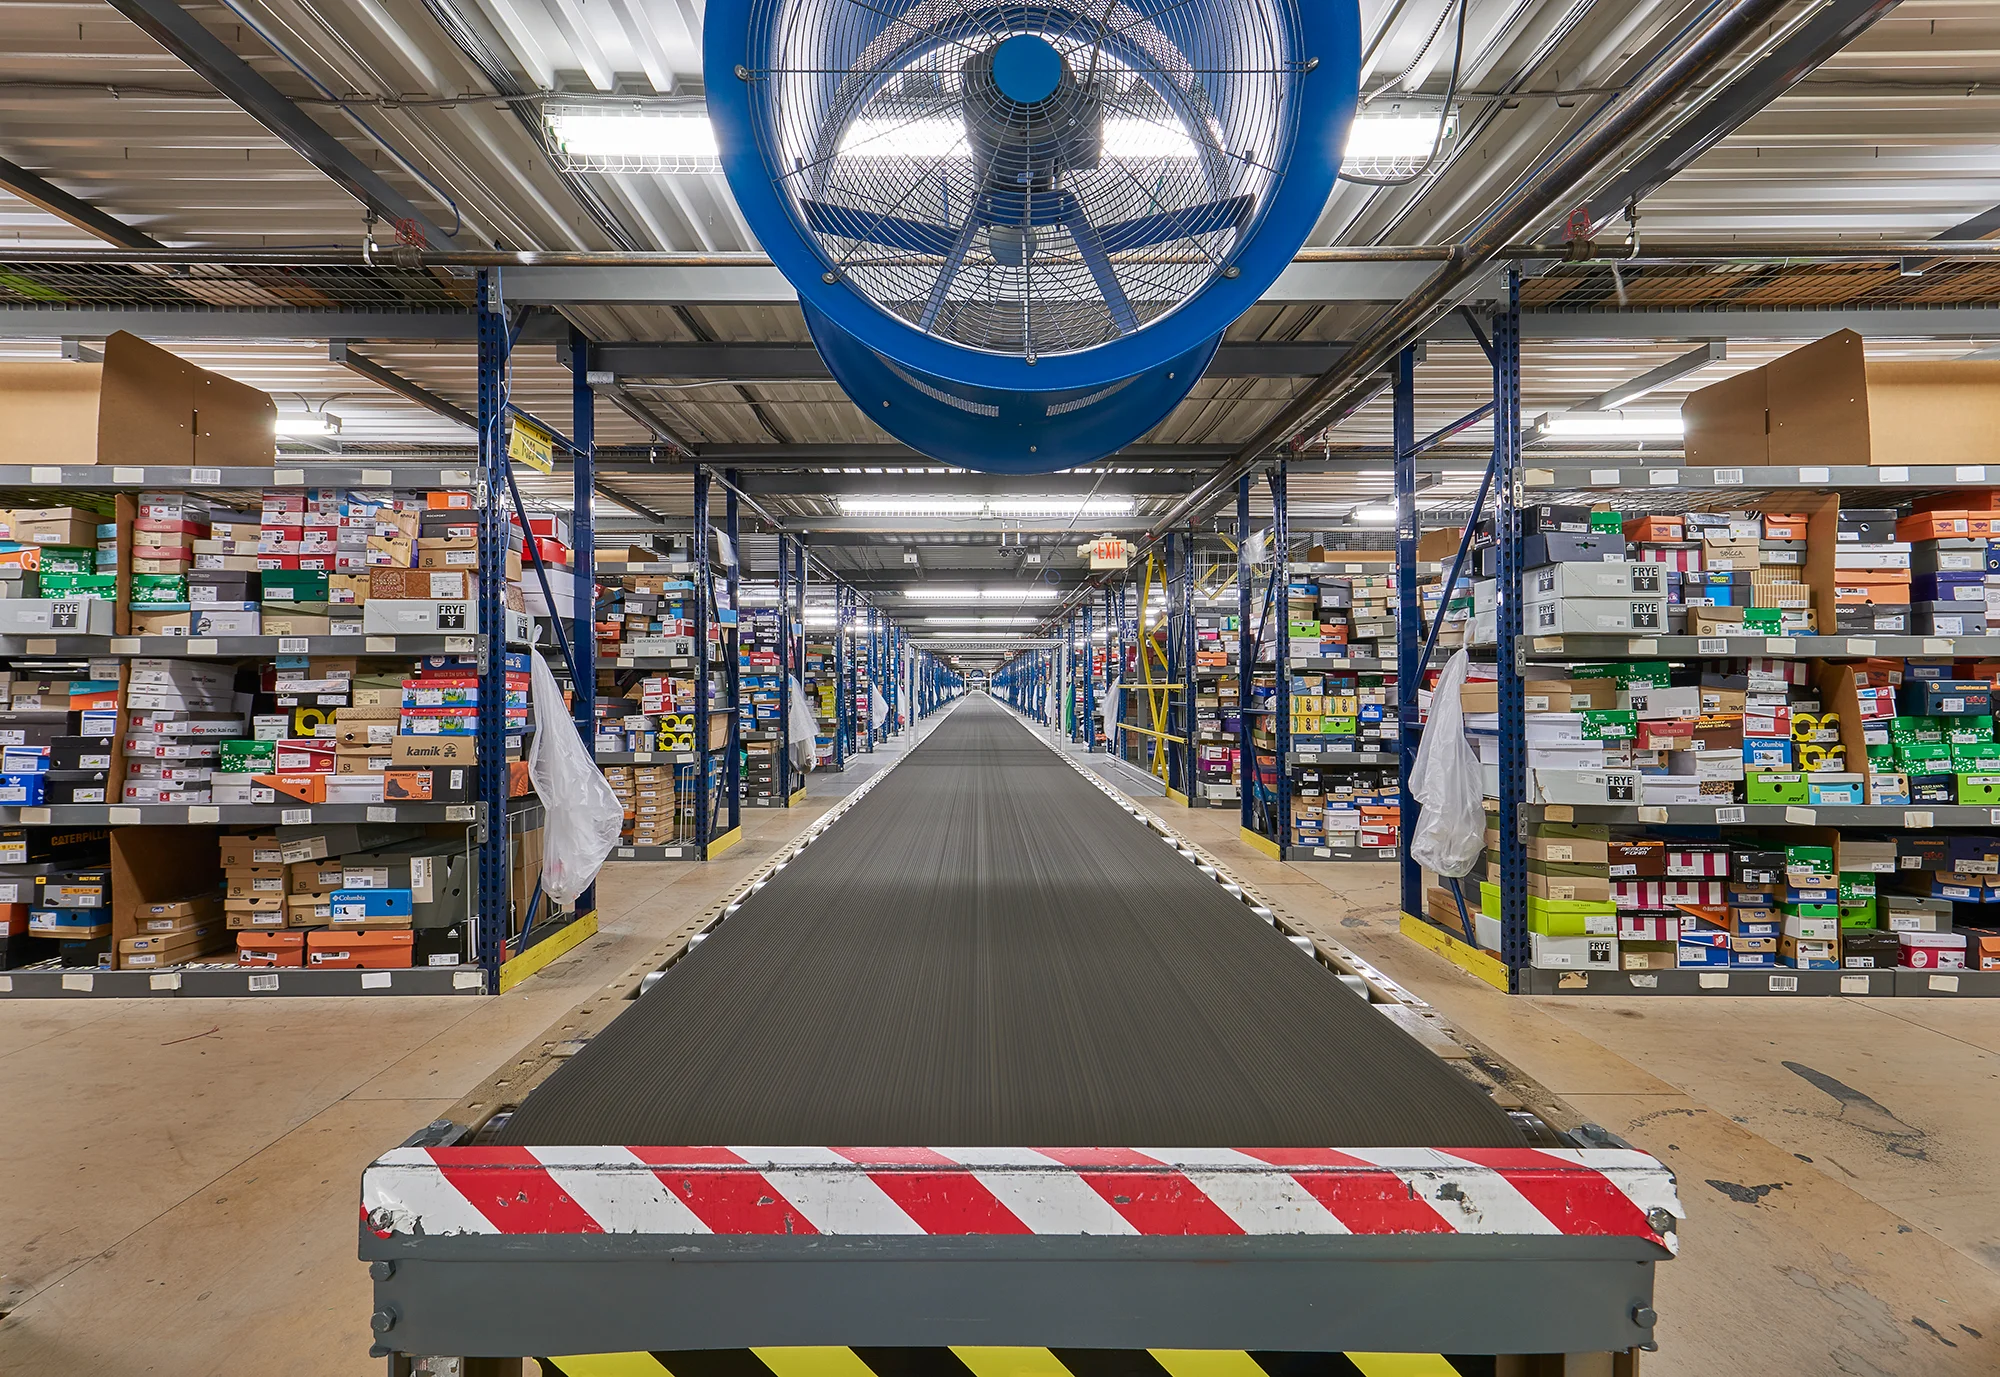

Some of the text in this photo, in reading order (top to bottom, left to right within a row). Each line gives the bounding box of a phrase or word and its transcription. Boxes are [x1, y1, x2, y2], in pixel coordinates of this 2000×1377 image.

[1098, 542, 1121, 559] EXIT
[1632, 568, 1657, 576] FRYE
[53, 604, 78, 612] FRYE
[439, 606, 465, 614] FRYE
[1539, 604, 1554, 613] FRYE
[1632, 604, 1657, 612] FRYE
[1122, 629, 1138, 639] 125
[407, 746, 440, 756] kamik
[1608, 777, 1632, 785] FRYE
[51, 830, 112, 846] CATERPILLA
[1590, 942, 1610, 950] FRYE
